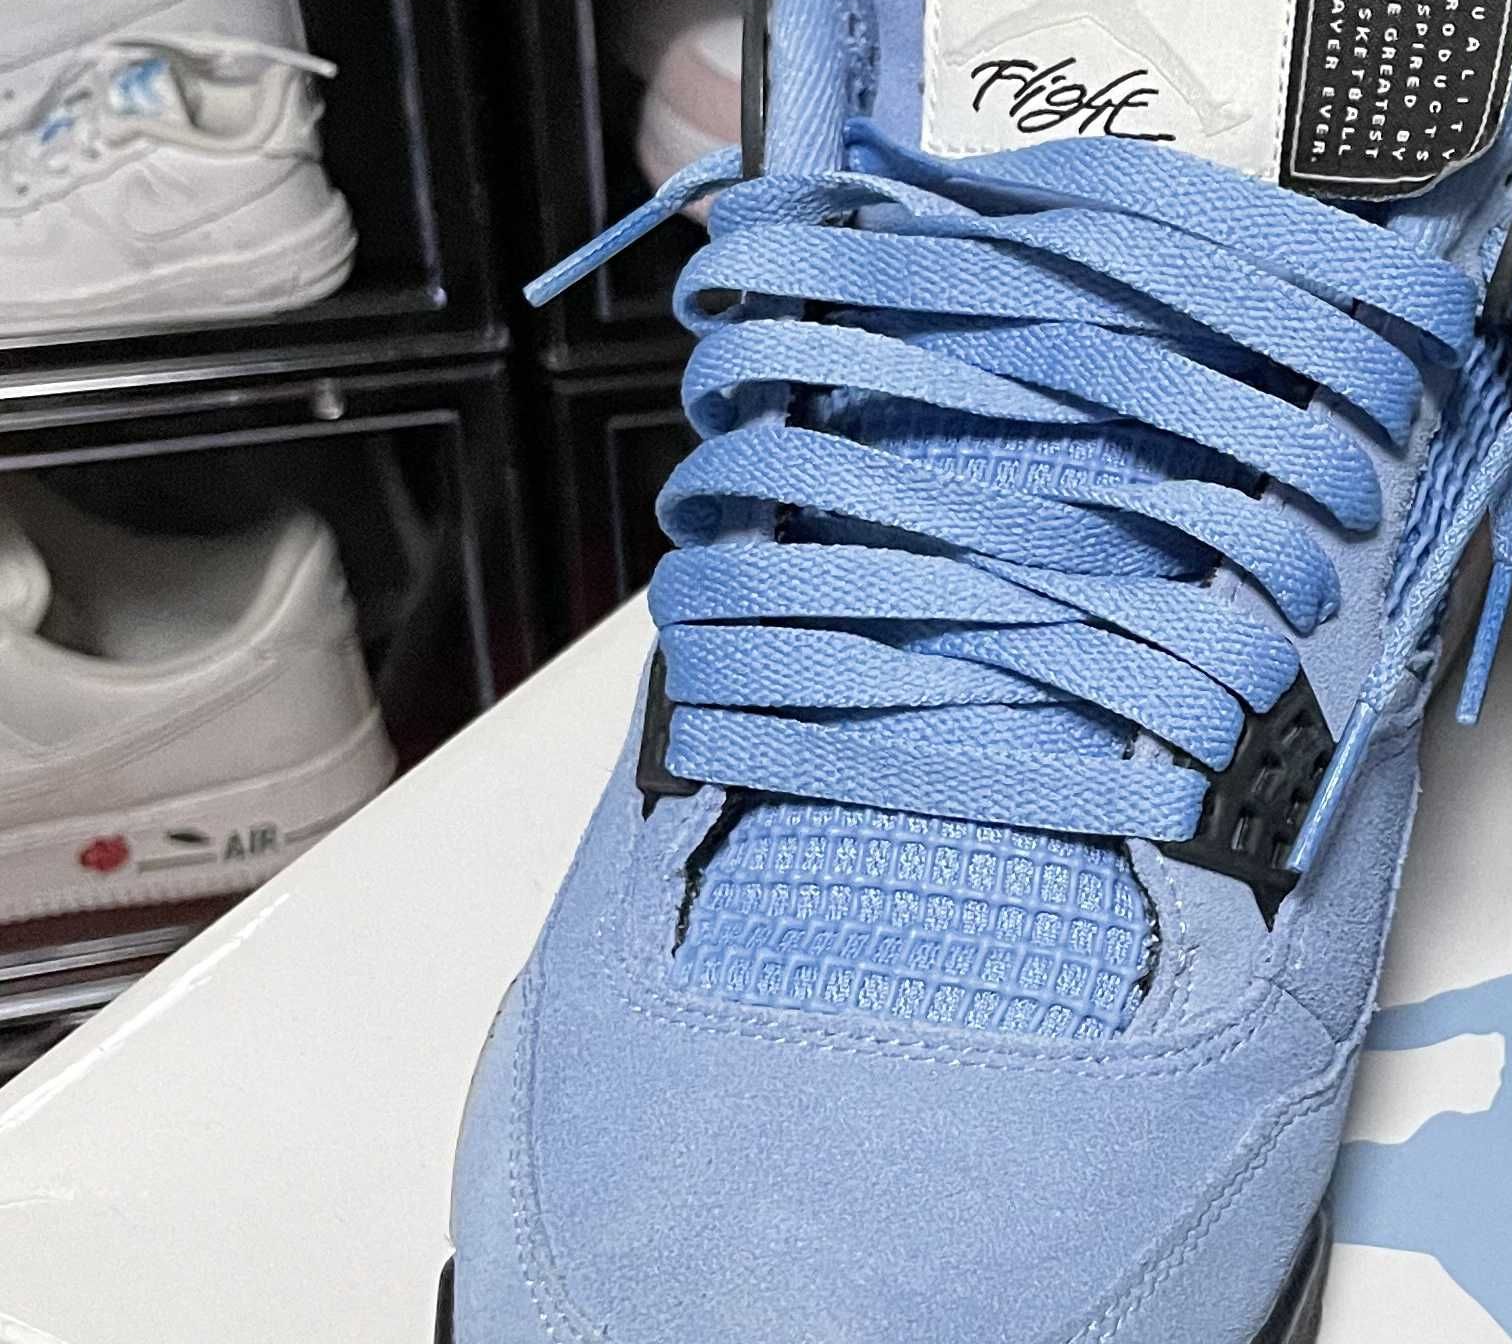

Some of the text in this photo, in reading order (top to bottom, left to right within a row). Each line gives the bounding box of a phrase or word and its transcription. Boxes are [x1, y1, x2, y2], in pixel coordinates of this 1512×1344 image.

[970, 57, 1176, 142] Flight
[1364, 27, 1400, 159] GREATEST
[1391, 129, 1411, 161] BY
[223, 821, 279, 862] AIR
